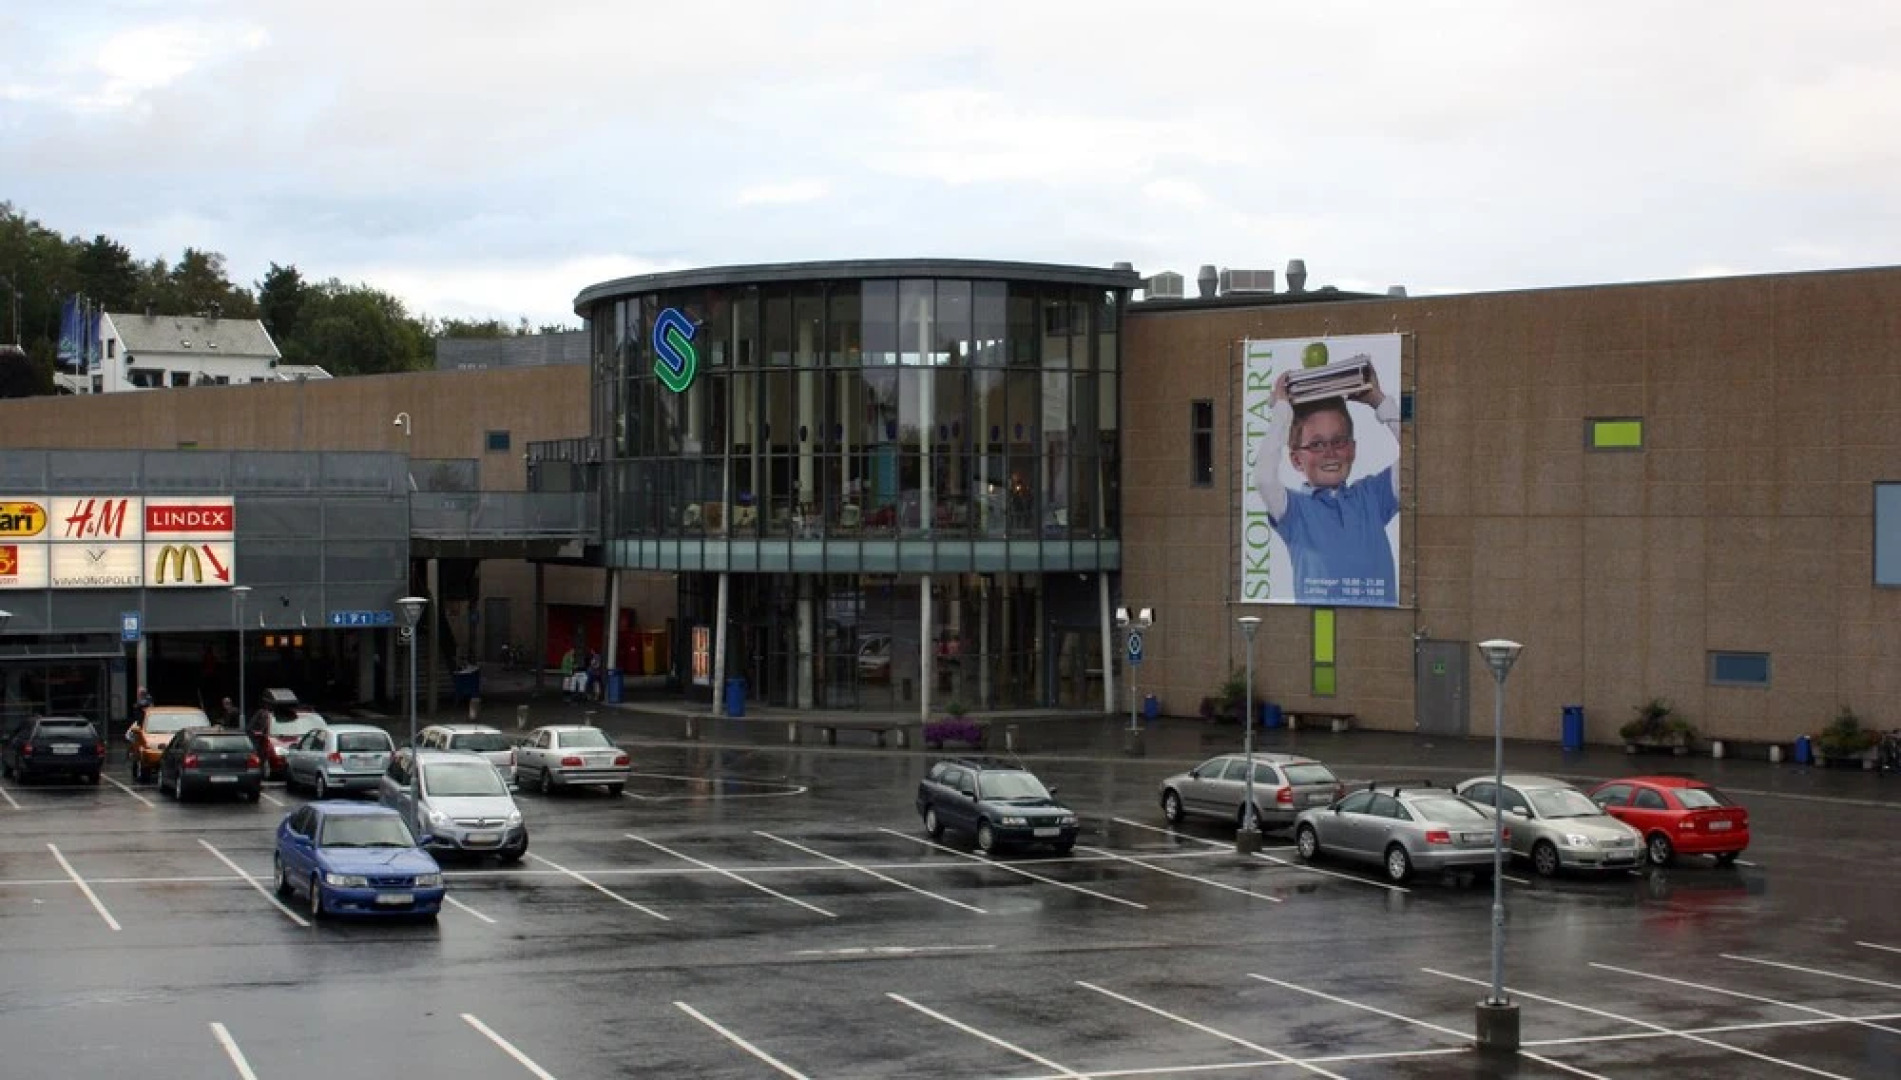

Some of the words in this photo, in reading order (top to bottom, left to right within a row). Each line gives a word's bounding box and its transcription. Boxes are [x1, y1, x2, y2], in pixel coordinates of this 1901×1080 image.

[0, 507, 33, 531] ari
[65, 498, 128, 538] H&M
[153, 511, 225, 526] LINDEX
